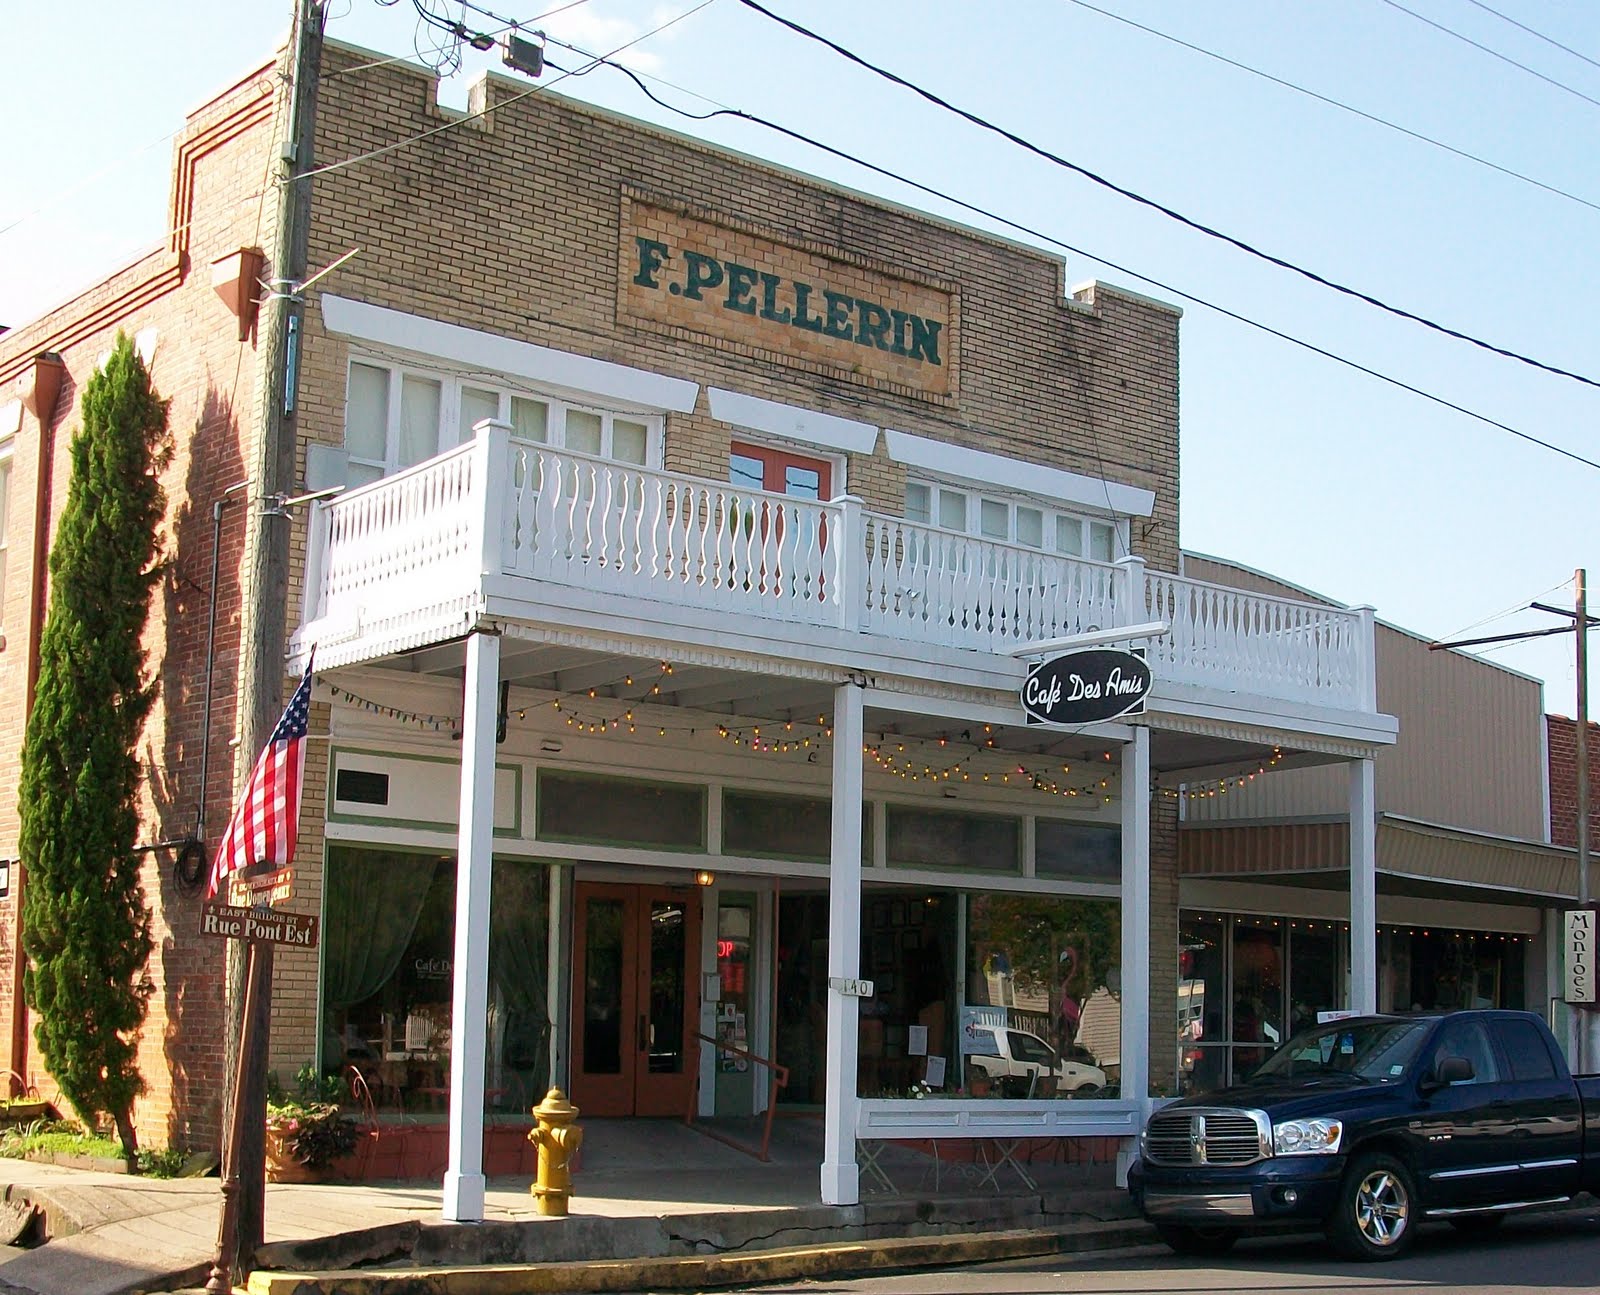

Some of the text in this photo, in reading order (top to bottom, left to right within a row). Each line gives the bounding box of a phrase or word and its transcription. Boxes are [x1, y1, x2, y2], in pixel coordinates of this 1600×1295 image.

[1027, 667, 1143, 714] Café Des Amis
[220, 907, 299, 925] EAST BRIDGE ST
[203, 914, 311, 945] Rue Pont Est
[844, 979, 868, 995] 140
